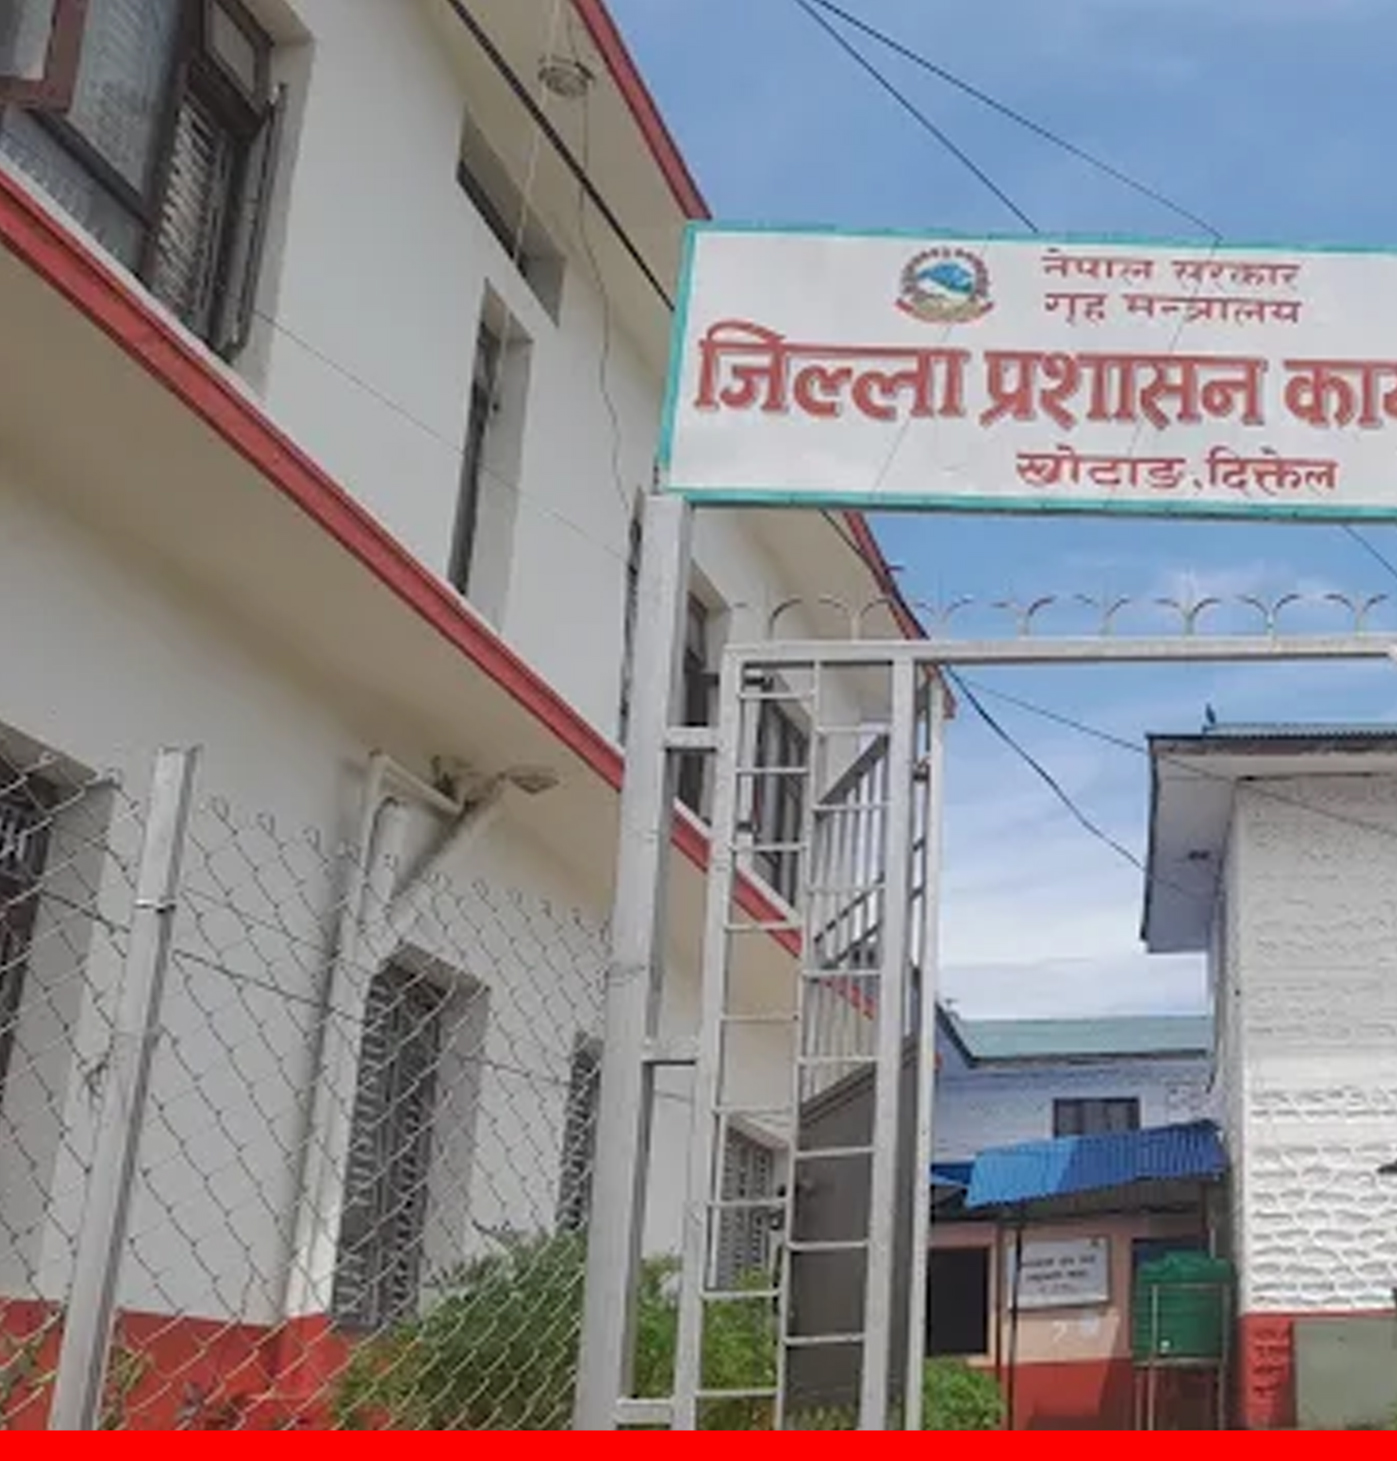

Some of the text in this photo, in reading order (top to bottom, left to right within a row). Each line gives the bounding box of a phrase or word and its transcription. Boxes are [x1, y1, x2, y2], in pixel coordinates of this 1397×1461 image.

[1041, 247, 1302, 289] नेपाल सरकार
[1044, 292, 1302, 326] गृह मन्त्रालय
[693, 320, 970, 421] जिल्ला
[977, 348, 1269, 430] प्रशासन
